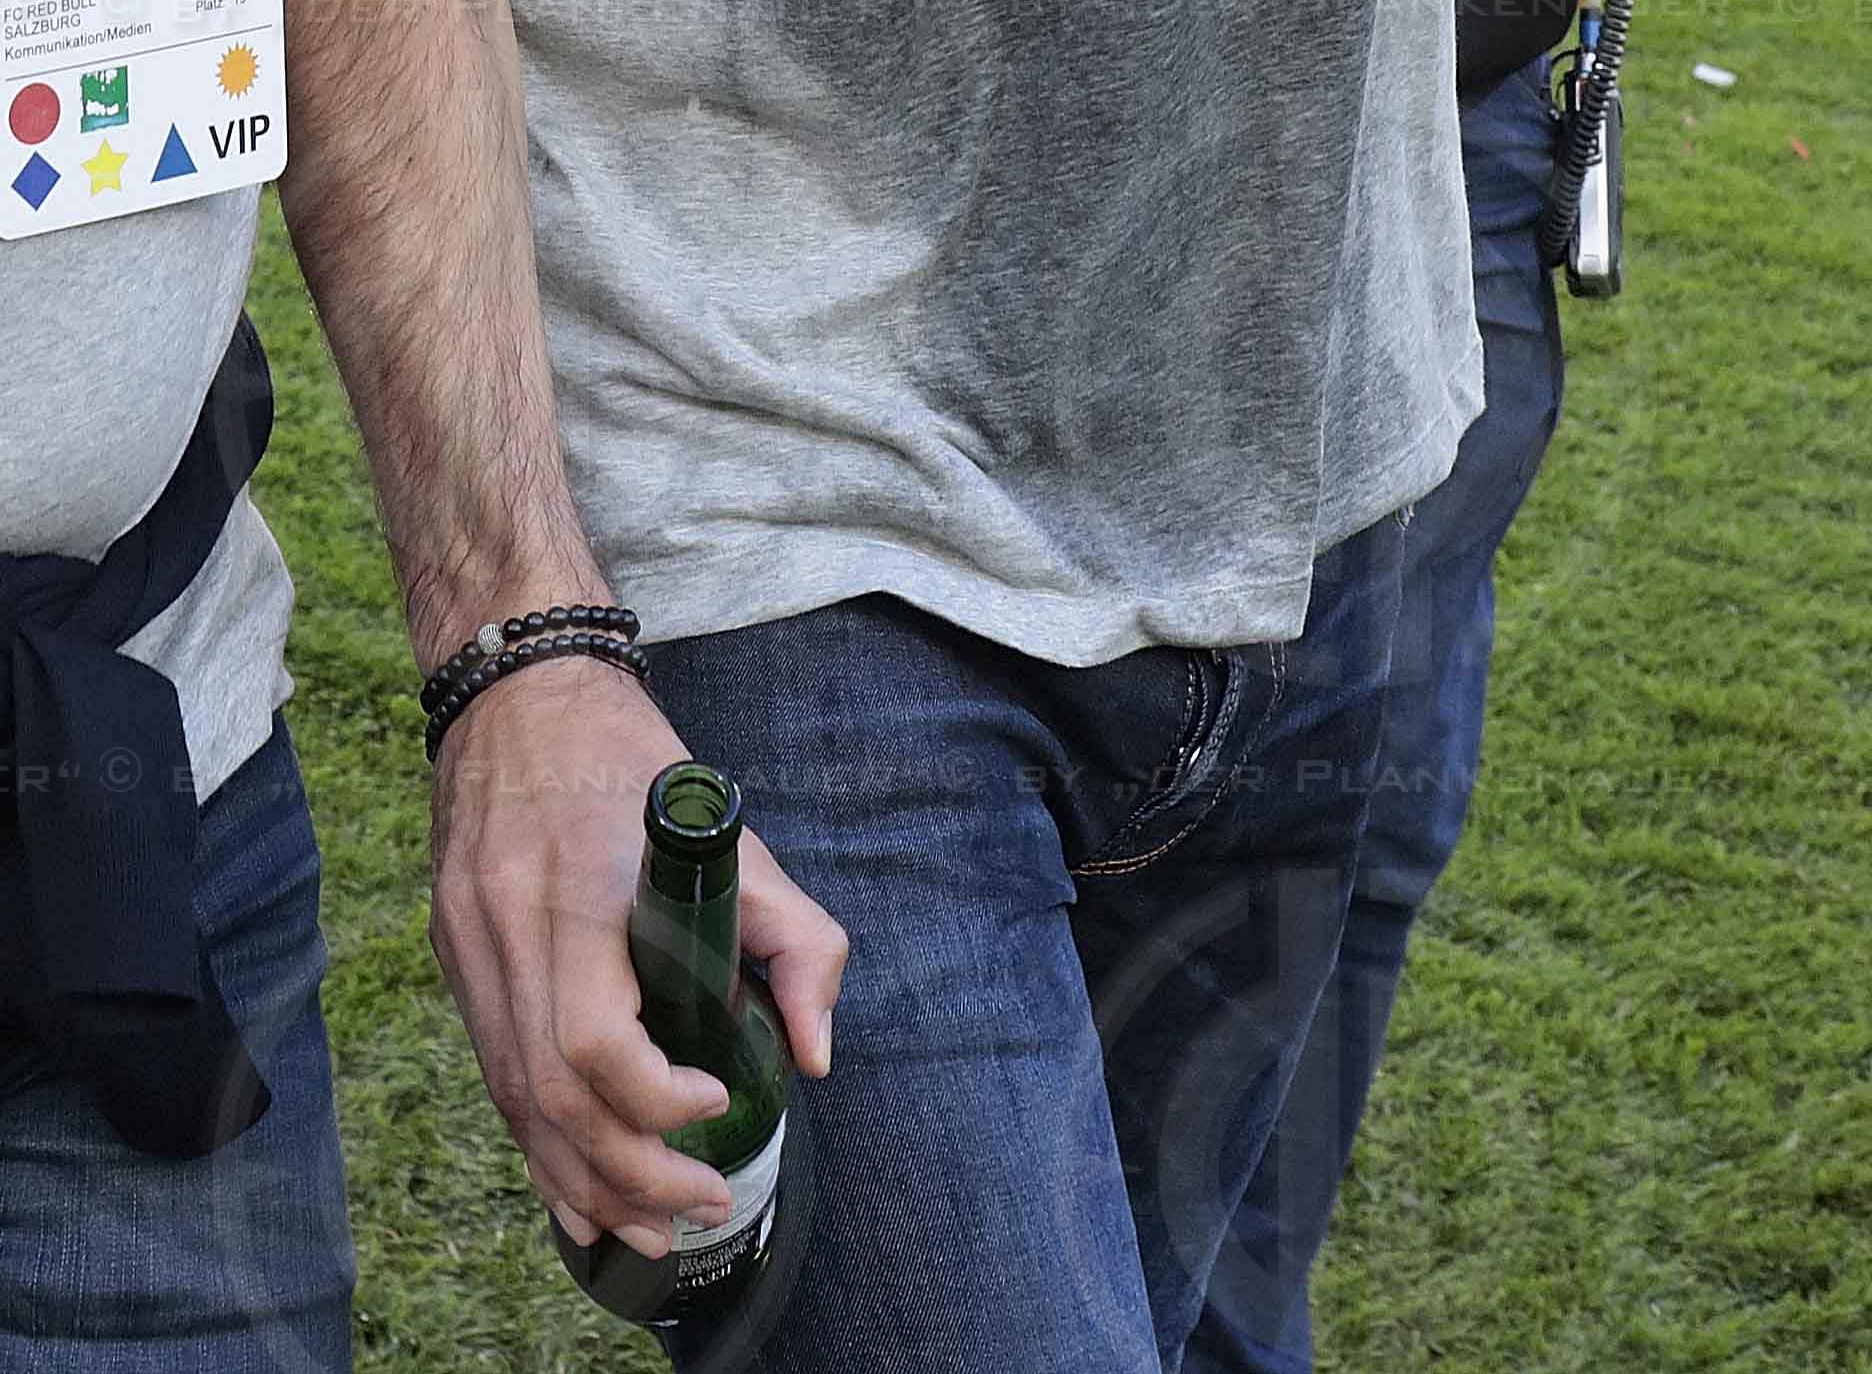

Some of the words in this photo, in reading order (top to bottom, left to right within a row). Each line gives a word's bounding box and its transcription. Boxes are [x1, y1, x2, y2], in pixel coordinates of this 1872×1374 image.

[3, 7, 26, 23] FC
[26, 0, 58, 19] RED
[4, 14, 82, 40] SALZBURG
[4, 22, 153, 61] Kommunikation/Medien
[208, 113, 271, 160] VIP
